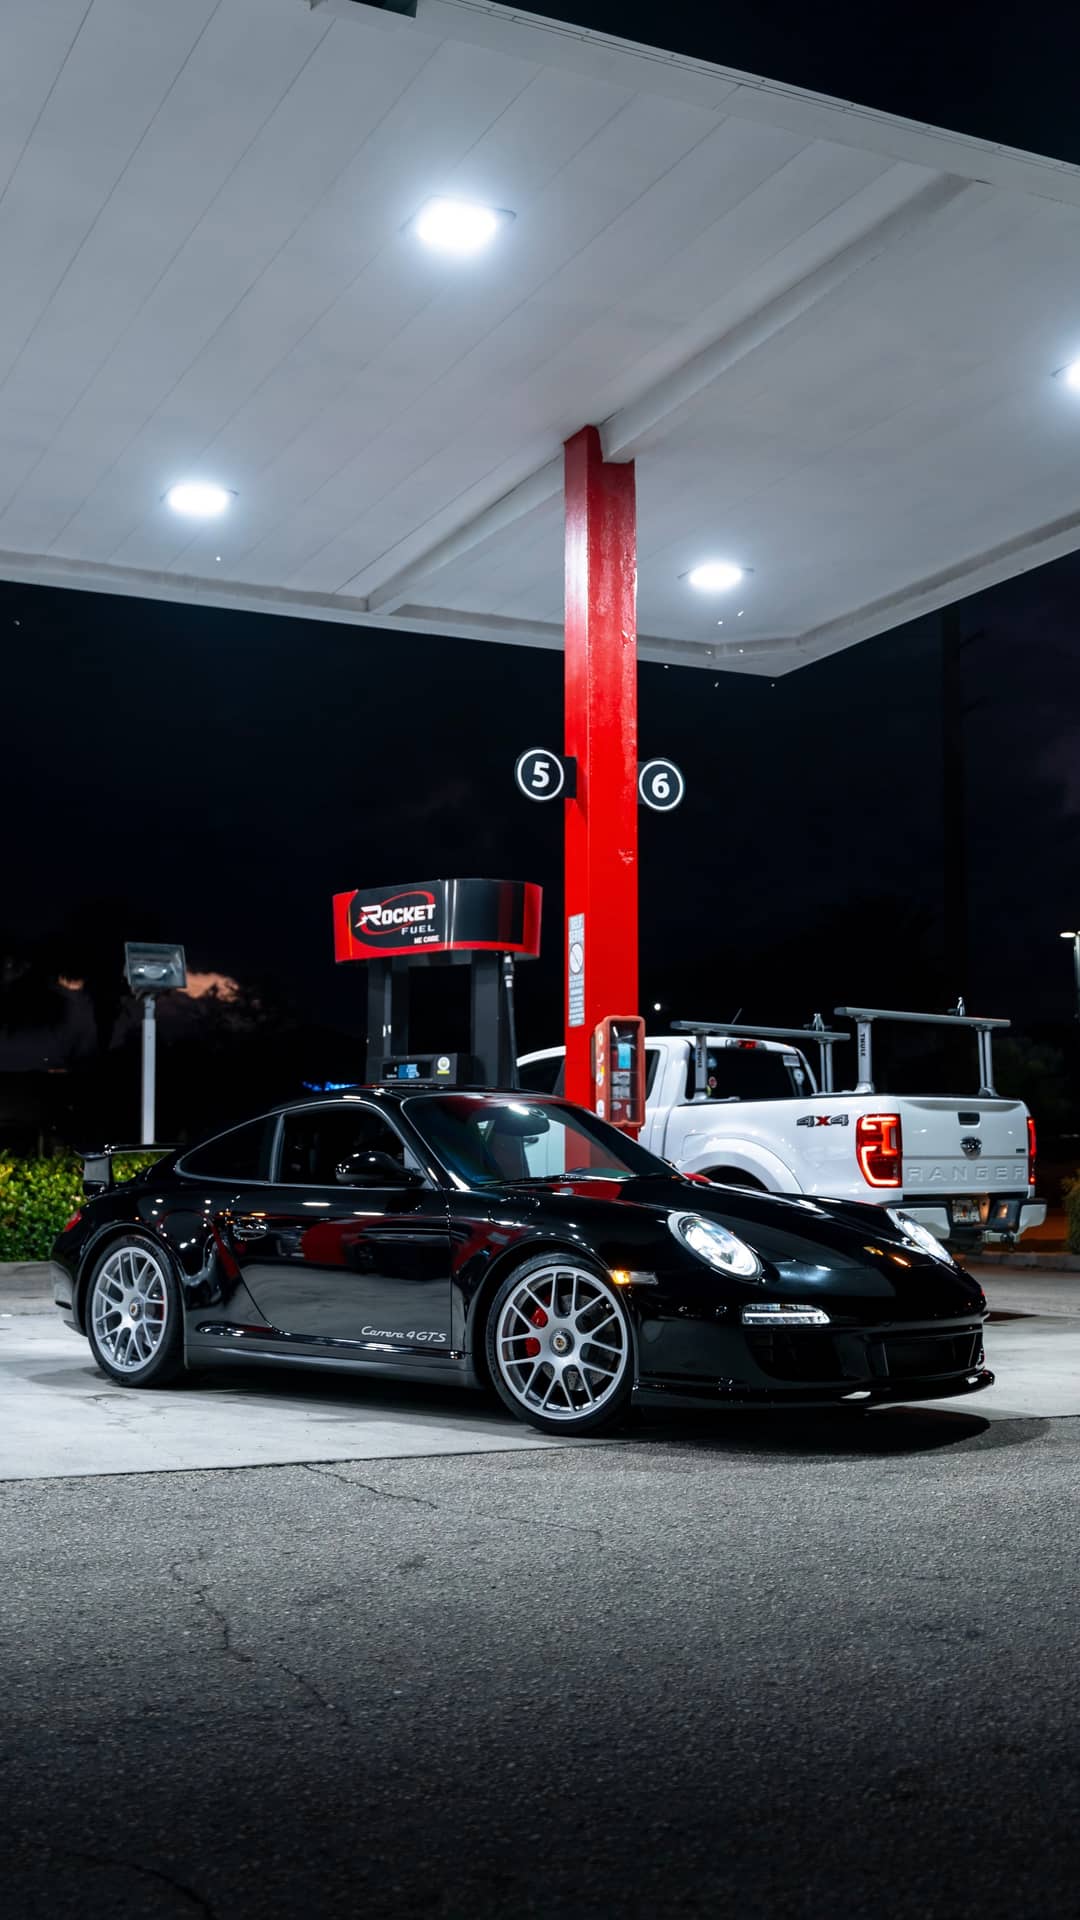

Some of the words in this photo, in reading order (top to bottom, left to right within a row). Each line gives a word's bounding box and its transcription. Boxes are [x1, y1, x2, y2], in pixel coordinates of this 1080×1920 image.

[531, 761, 550, 788] 5
[651, 773, 670, 798] 6
[355, 904, 436, 928] ROCKET
[401, 924, 435, 935] FUEL
[907, 1165, 1026, 1182] RANGER
[361, 1325, 405, 1339] Carrera
